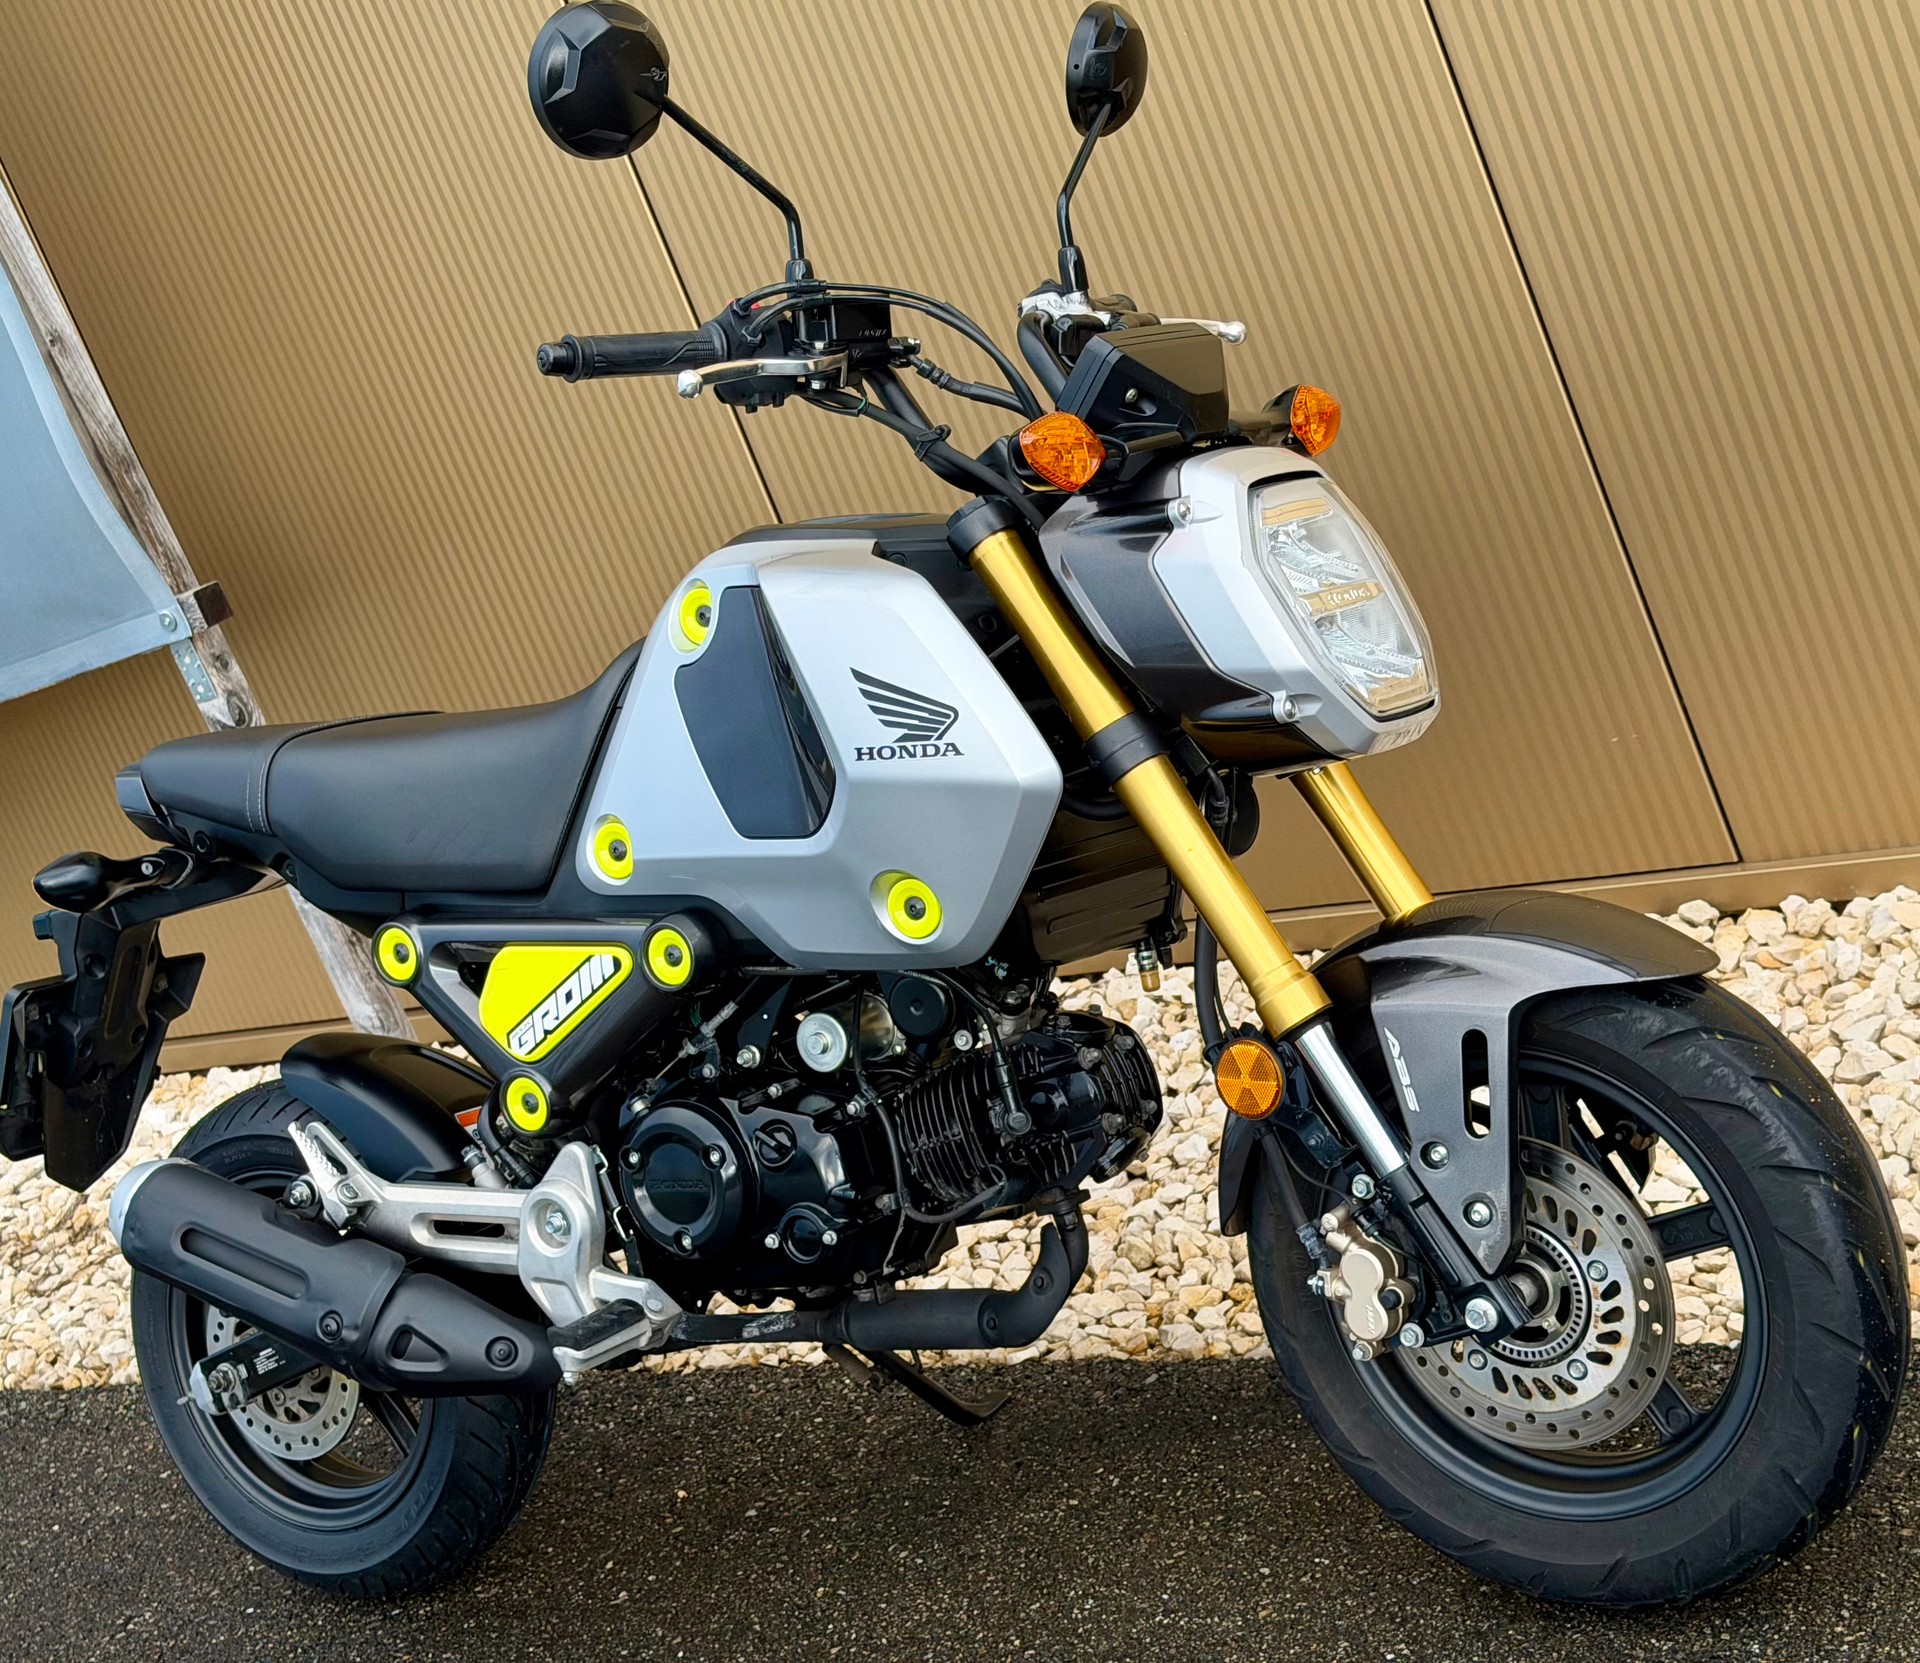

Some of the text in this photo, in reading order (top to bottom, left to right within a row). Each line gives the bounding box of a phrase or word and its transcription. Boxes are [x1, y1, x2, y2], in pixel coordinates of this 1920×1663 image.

[854, 742, 965, 761] HONDA
[508, 953, 616, 1056] GROM
[1383, 1026, 1420, 1113] ABS
